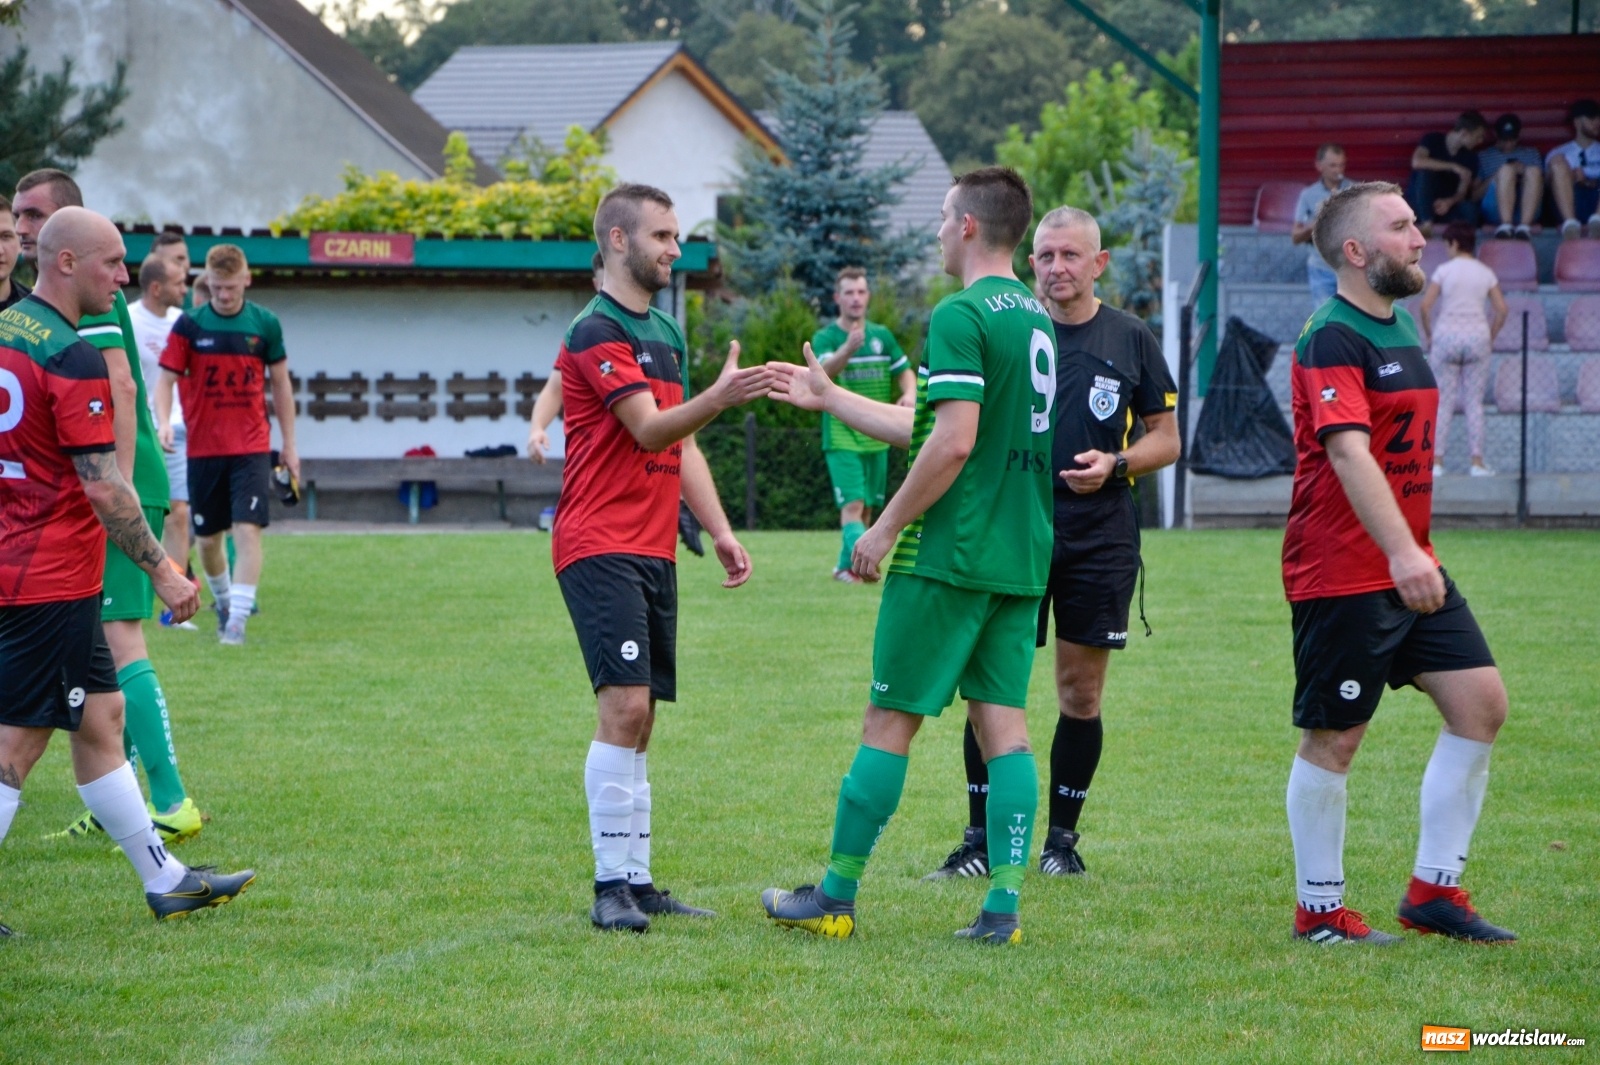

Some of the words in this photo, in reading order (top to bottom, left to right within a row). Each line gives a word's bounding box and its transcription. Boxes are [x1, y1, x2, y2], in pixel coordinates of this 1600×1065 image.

[324, 238, 392, 259] CZARNI
[985, 293, 1016, 312] LKS
[1029, 327, 1057, 433] 9
[1385, 411, 1415, 454] Z
[1421, 420, 1432, 451] &
[1385, 459, 1421, 477] Farby
